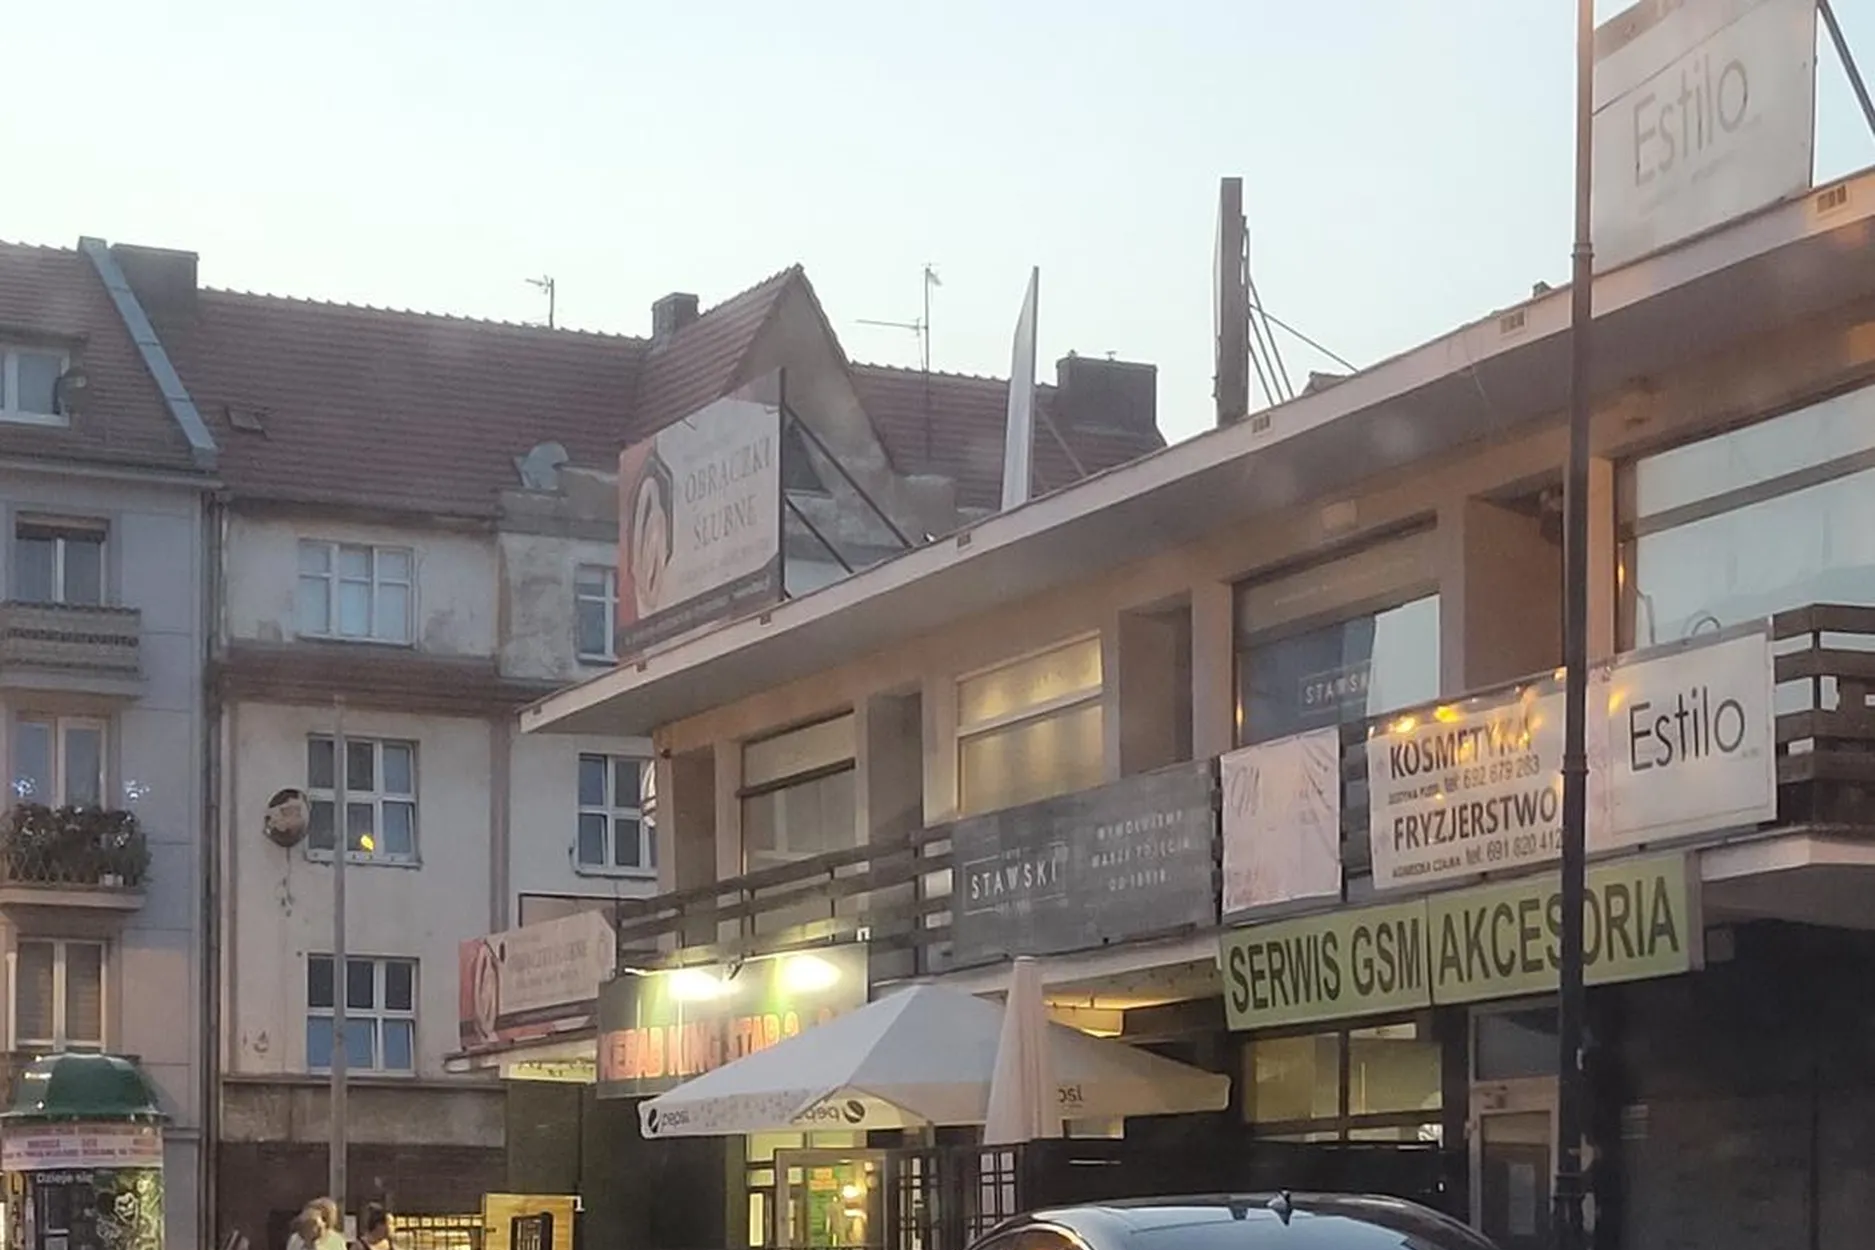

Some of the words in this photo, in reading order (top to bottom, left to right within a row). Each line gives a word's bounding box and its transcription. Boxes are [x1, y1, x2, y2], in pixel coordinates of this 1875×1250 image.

[1633, 54, 1748, 187] Estilo
[1390, 714, 1532, 780] KOSMETYKA
[1630, 686, 1745, 772] Estilo
[1394, 787, 1558, 852] FRYZJERSTWO
[971, 859, 1058, 900] STAWSKI
[1230, 931, 1340, 1013] SERWIS
[1351, 917, 1421, 997] GSM
[1438, 876, 1680, 985] AKCESORIA
